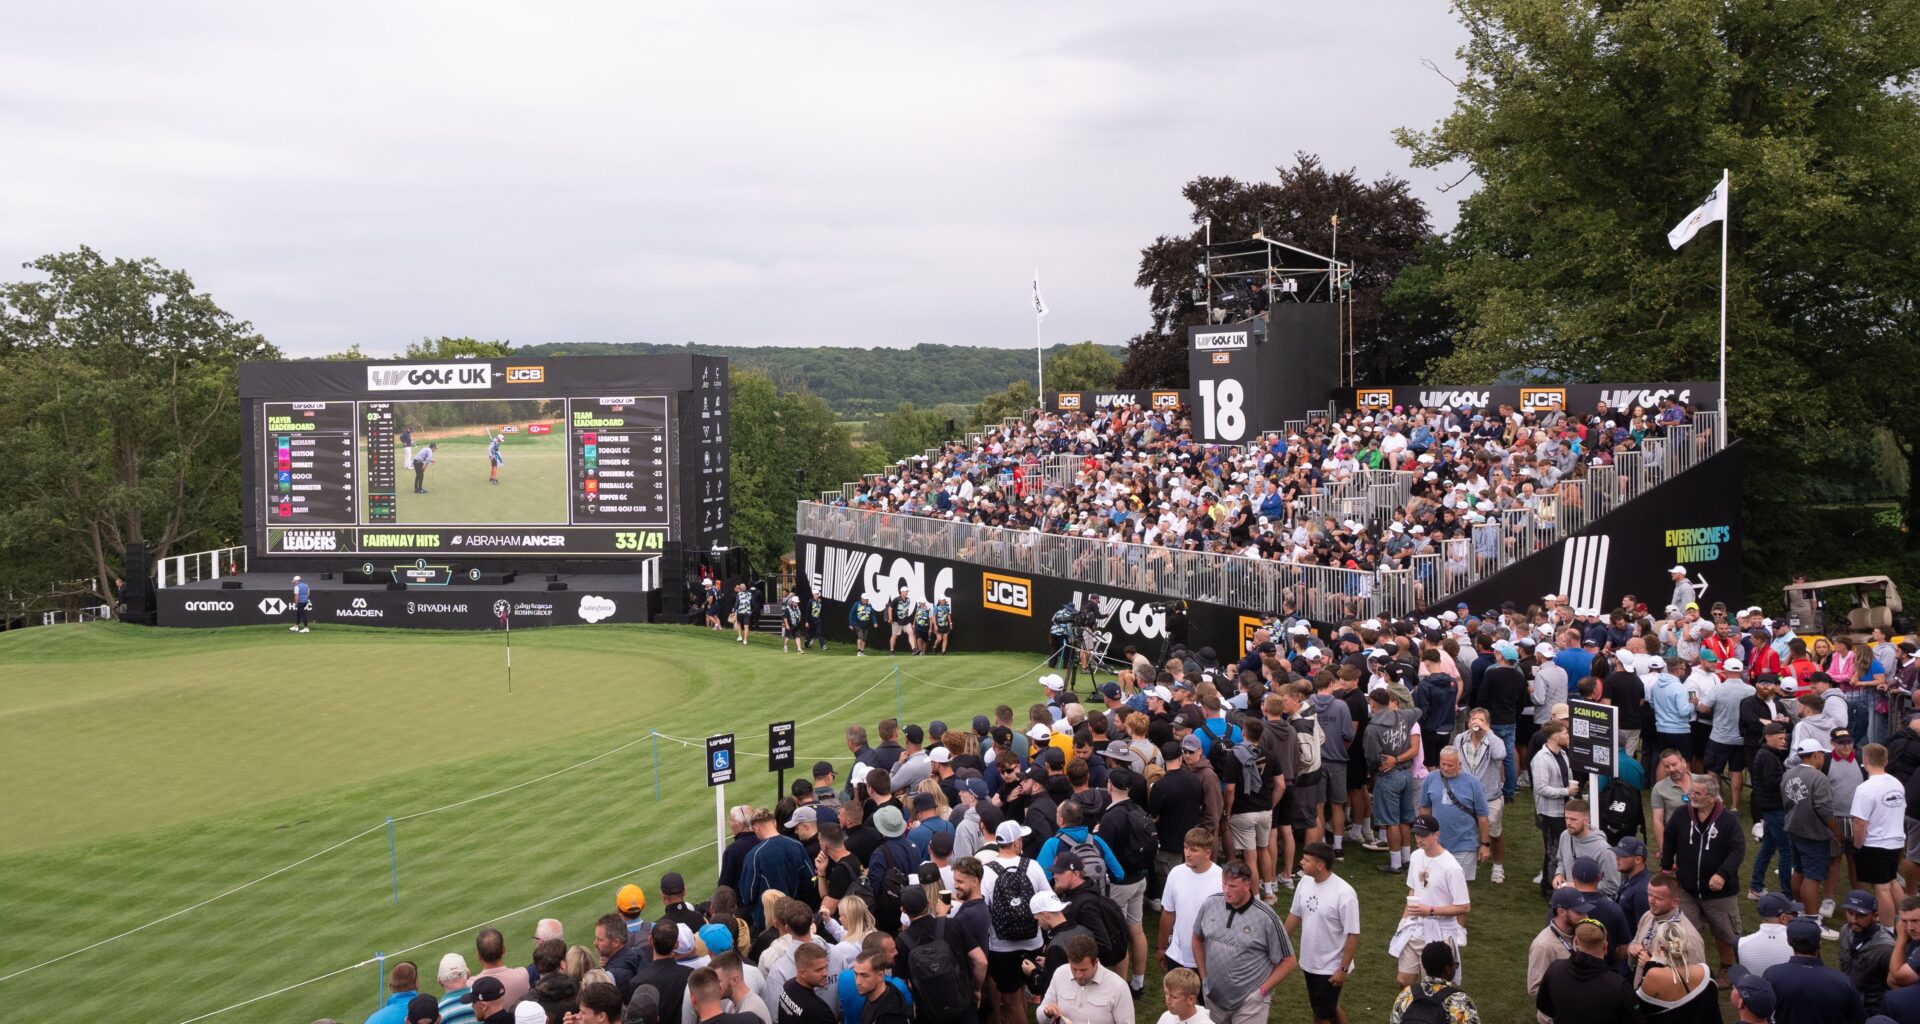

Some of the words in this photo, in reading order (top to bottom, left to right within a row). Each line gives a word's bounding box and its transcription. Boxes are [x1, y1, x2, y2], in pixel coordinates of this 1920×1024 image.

[1212, 336, 1230, 345] GOLF
[1233, 334, 1245, 344] UK
[408, 369, 453, 384] GOLF
[459, 368, 486, 384] UK
[510, 369, 541, 380] JCB
[1060, 396, 1078, 405] JCB
[1155, 396, 1176, 405] JCB
[1359, 393, 1389, 406] JCB
[1448, 391, 1490, 407] GOLF
[1525, 392, 1562, 407] JCB
[1199, 379, 1246, 440] 18
[268, 416, 292, 424] PLAYER
[574, 412, 592, 420] TEAM
[268, 423, 315, 431] LEADERBOARD
[574, 418, 624, 427] LEADERBOARD
[363, 535, 413, 547] FAIRWAY
[417, 535, 440, 547] HITS
[466, 535, 521, 546] ABRAHAM
[522, 535, 565, 546] ANCER
[615, 532, 663, 550] 33/41
[1665, 526, 1729, 547] EVERYONE'S
[283, 537, 336, 550] LEADERS
[1677, 544, 1719, 563] INVITED
[864, 553, 953, 618] GOLF
[987, 581, 1027, 608] JCB
[185, 600, 234, 611] aramco
[417, 604, 450, 613] RIYADH
[452, 604, 468, 613] AIR
[336, 609, 383, 617] MAADEN
[1574, 707, 1590, 717] SCAN
[1592, 711, 1608, 720] FOR:
[772, 746, 791, 754] VIEWING
